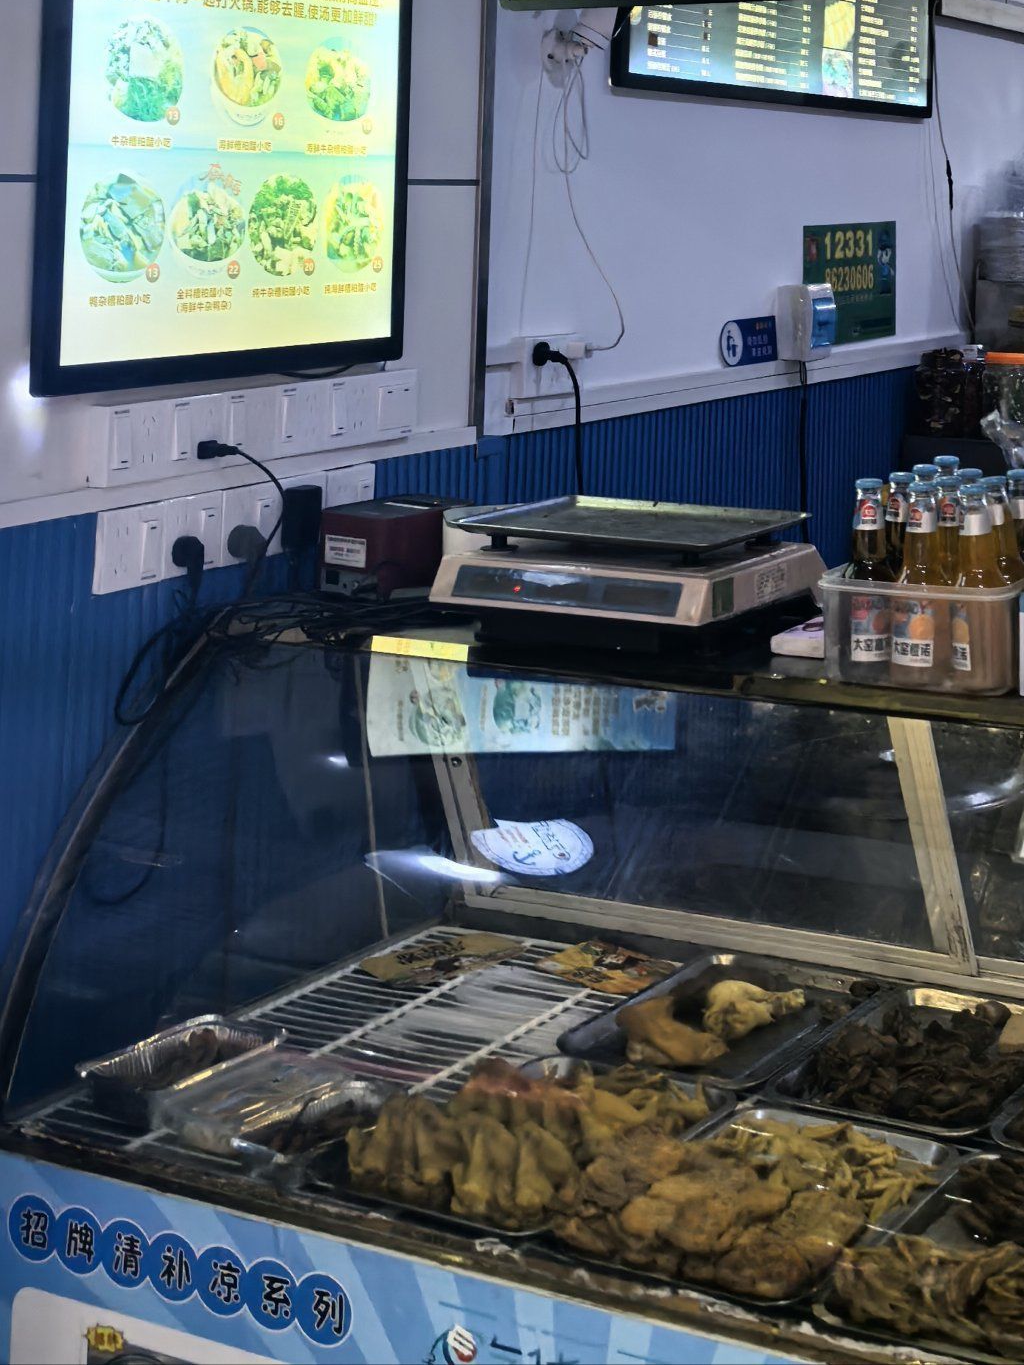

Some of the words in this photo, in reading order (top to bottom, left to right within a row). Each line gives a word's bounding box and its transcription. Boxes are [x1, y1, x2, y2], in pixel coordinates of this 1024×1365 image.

[824, 228, 874, 261] 12331
[20, 1205, 349, 1335] 招牌清补凉系列
